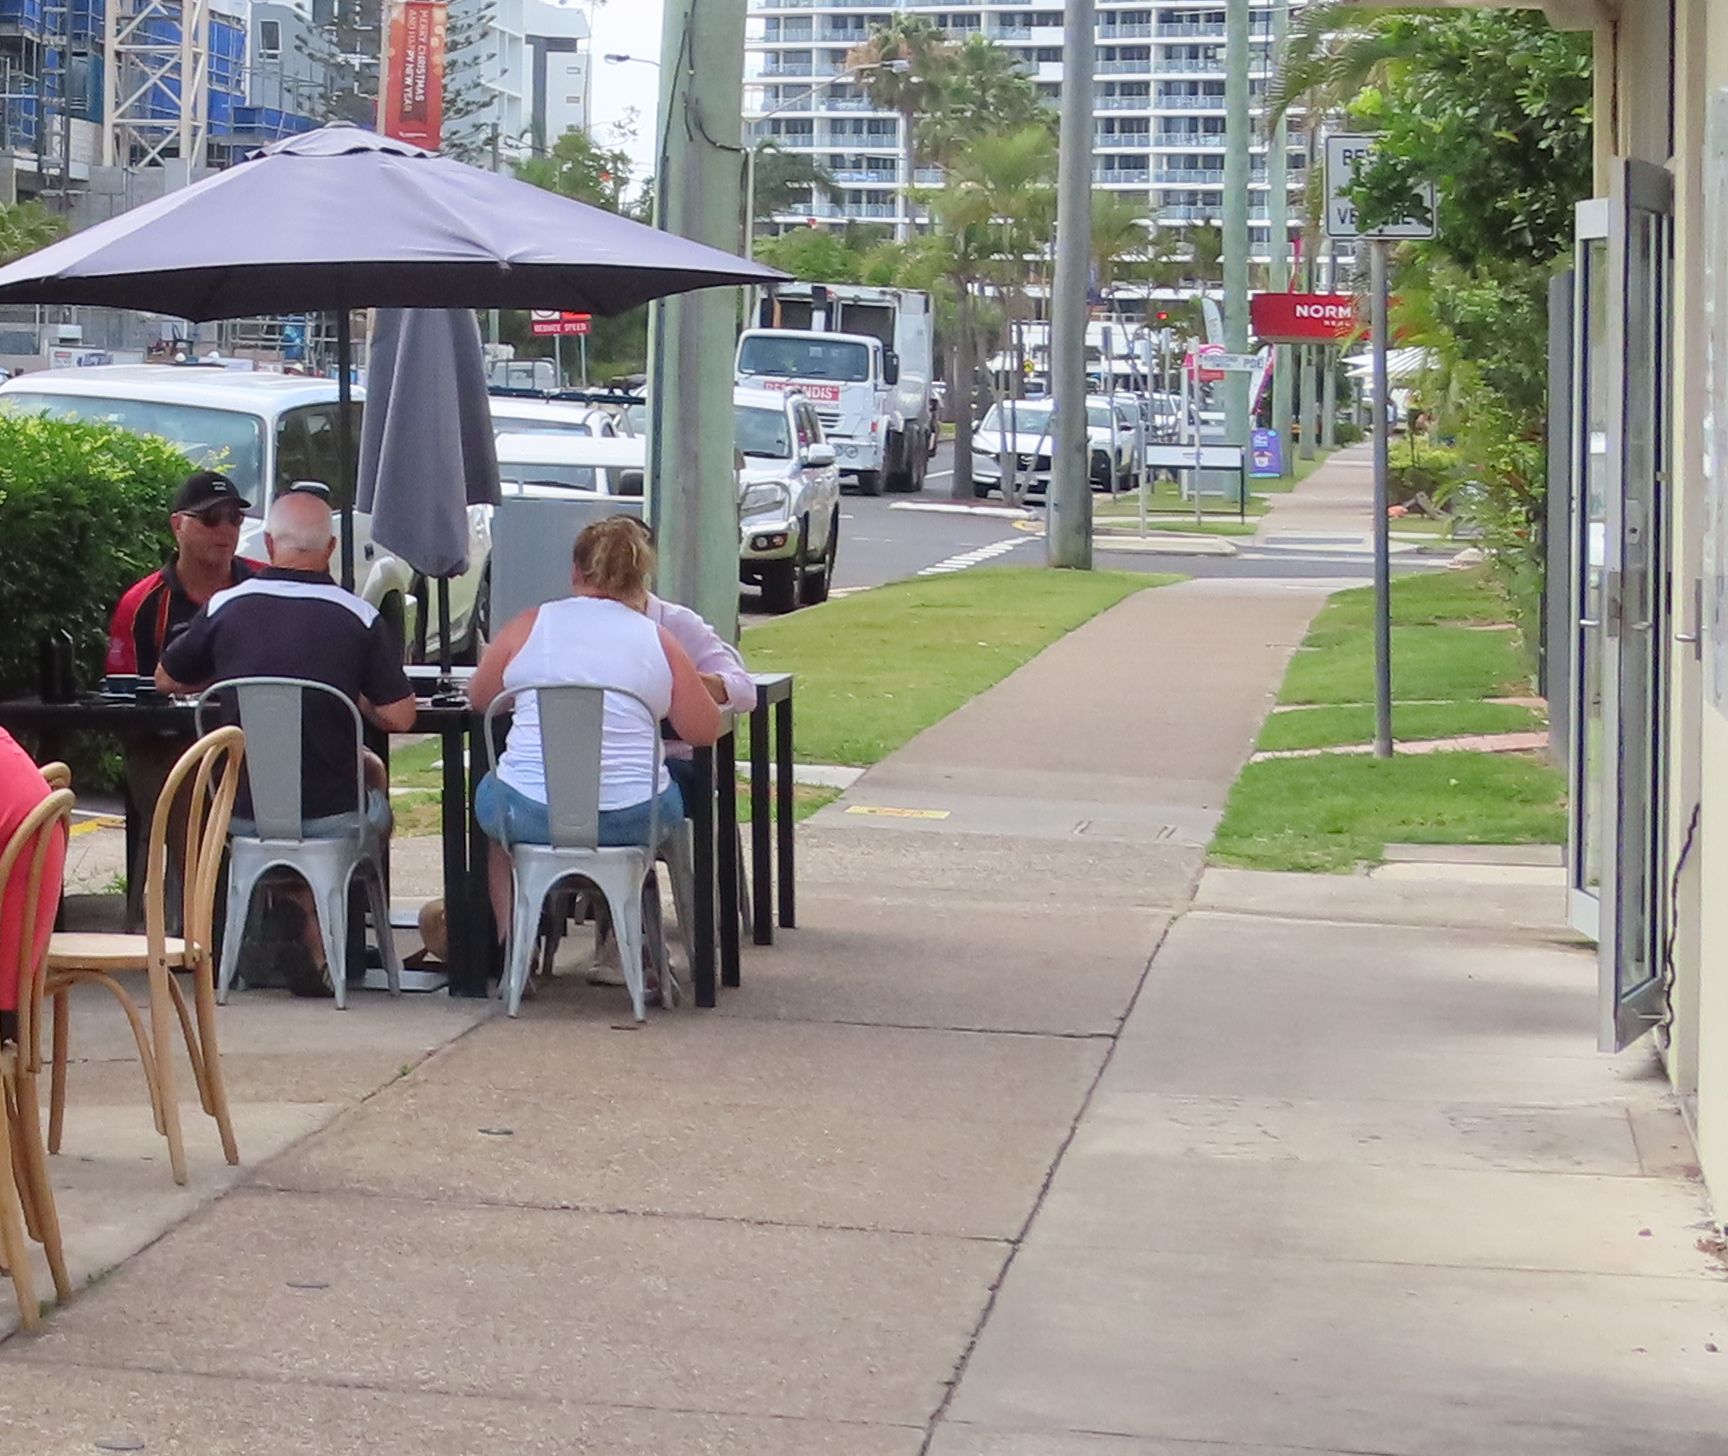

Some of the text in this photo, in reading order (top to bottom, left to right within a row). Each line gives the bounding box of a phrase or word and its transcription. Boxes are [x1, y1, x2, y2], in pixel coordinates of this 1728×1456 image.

[415, 9, 429, 102] MERRY CHRISTMAS
[404, 64, 414, 85] NEW
[403, 86, 413, 112] YEAR
[564, 323, 587, 332] SPEED
